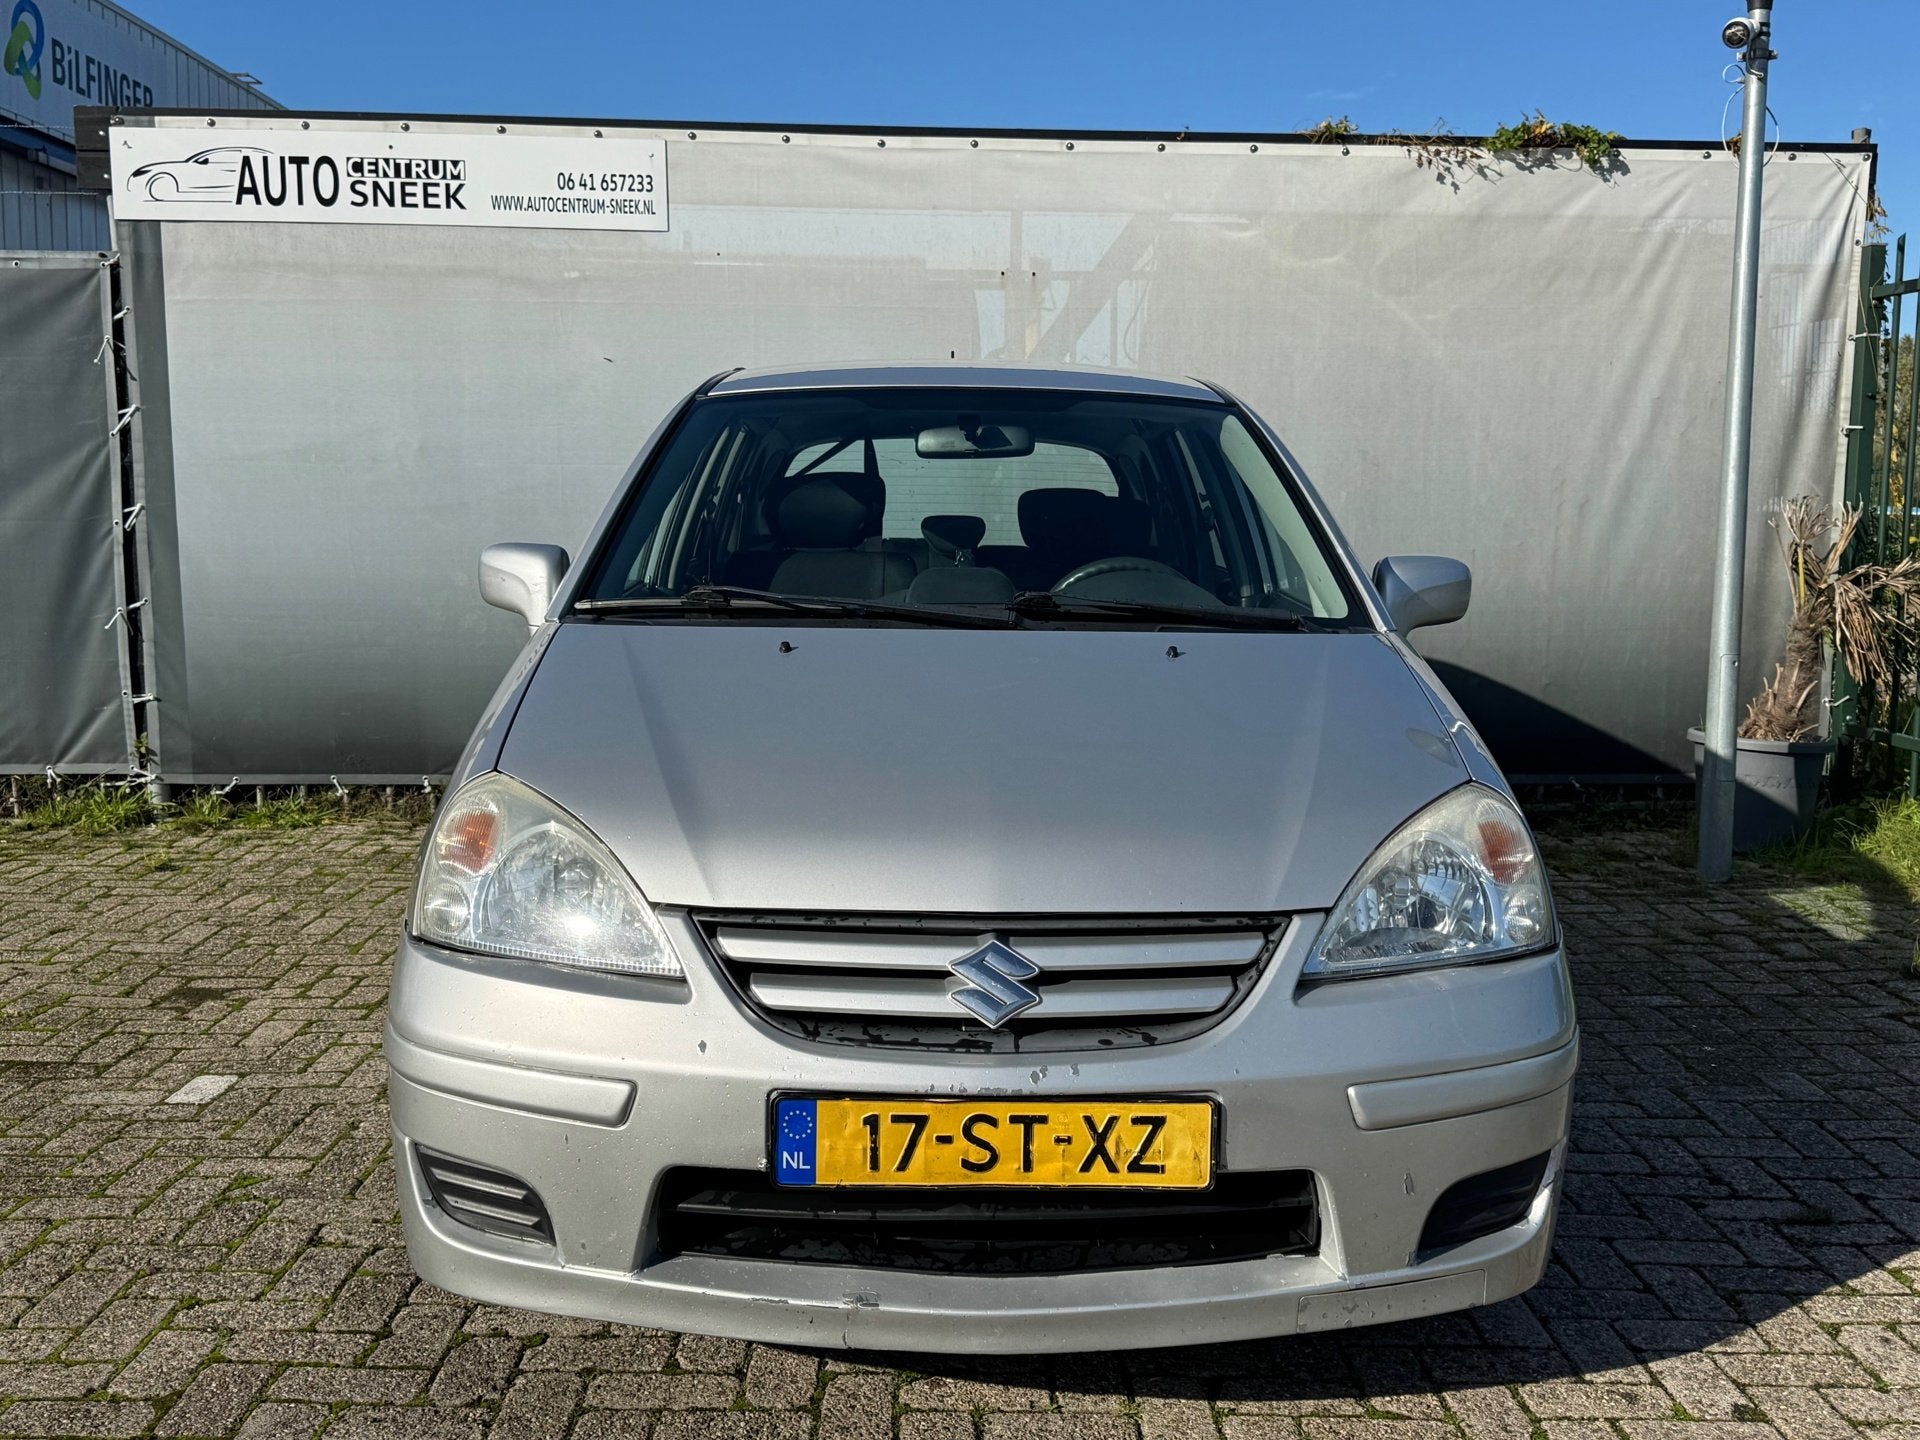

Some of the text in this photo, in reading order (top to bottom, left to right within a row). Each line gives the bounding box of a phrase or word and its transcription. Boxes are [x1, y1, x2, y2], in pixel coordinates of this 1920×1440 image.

[236, 155, 339, 207] AUTO
[346, 157, 466, 181] CENTRUM
[557, 172, 654, 193] 06 41 657233
[350, 180, 467, 210] SNEEK
[491, 195, 656, 215] WWW.AUTOCENTRUM-SNEEK.NL
[861, 1113, 1168, 1174] 17-ST-XZ
[782, 1151, 811, 1170] NL
